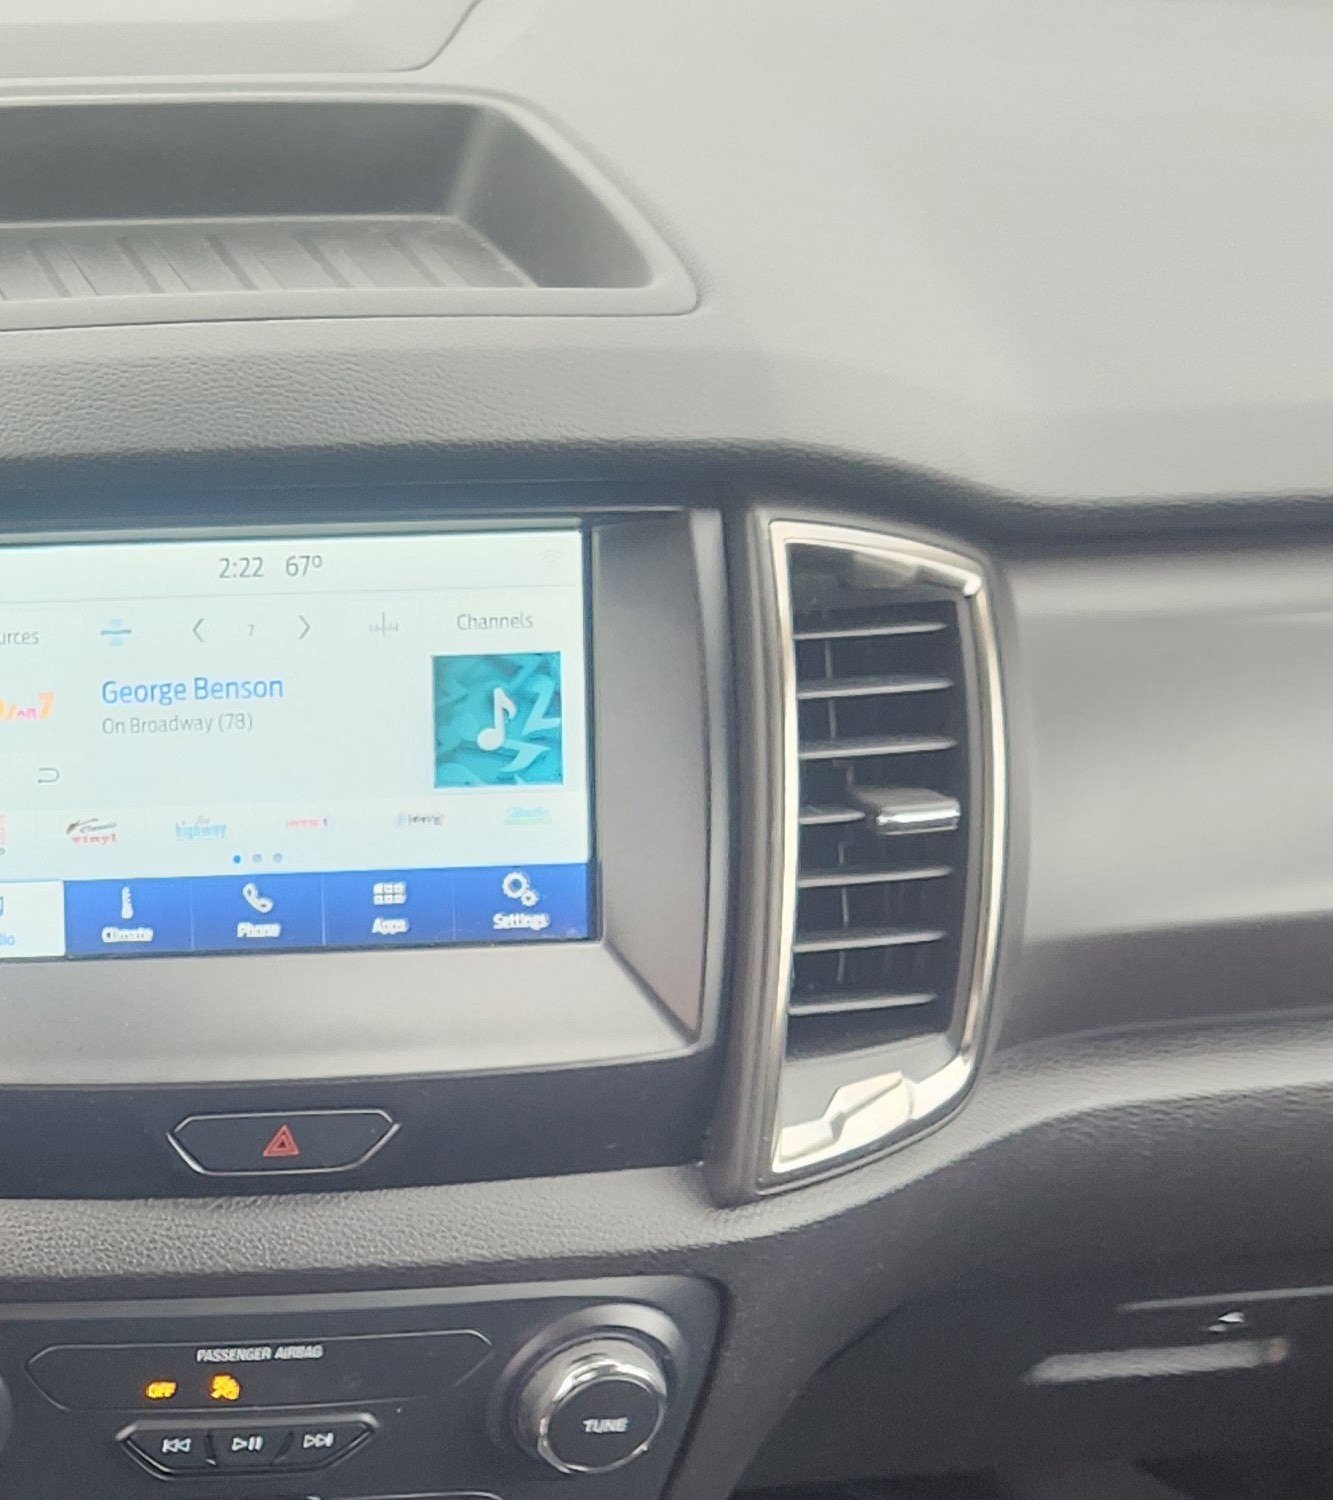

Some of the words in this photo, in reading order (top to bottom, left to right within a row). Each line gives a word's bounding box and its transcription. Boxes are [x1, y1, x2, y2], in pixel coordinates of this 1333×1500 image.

[219, 556, 265, 579] 2:22
[456, 611, 535, 632] Channels
[100, 679, 189, 707] George
[193, 677, 285, 702] Benson
[101, 716, 126, 736] On
[129, 714, 214, 737] Broadway
[196, 1346, 272, 1363] PASSENGER
[582, 1415, 631, 1434] TUNE
